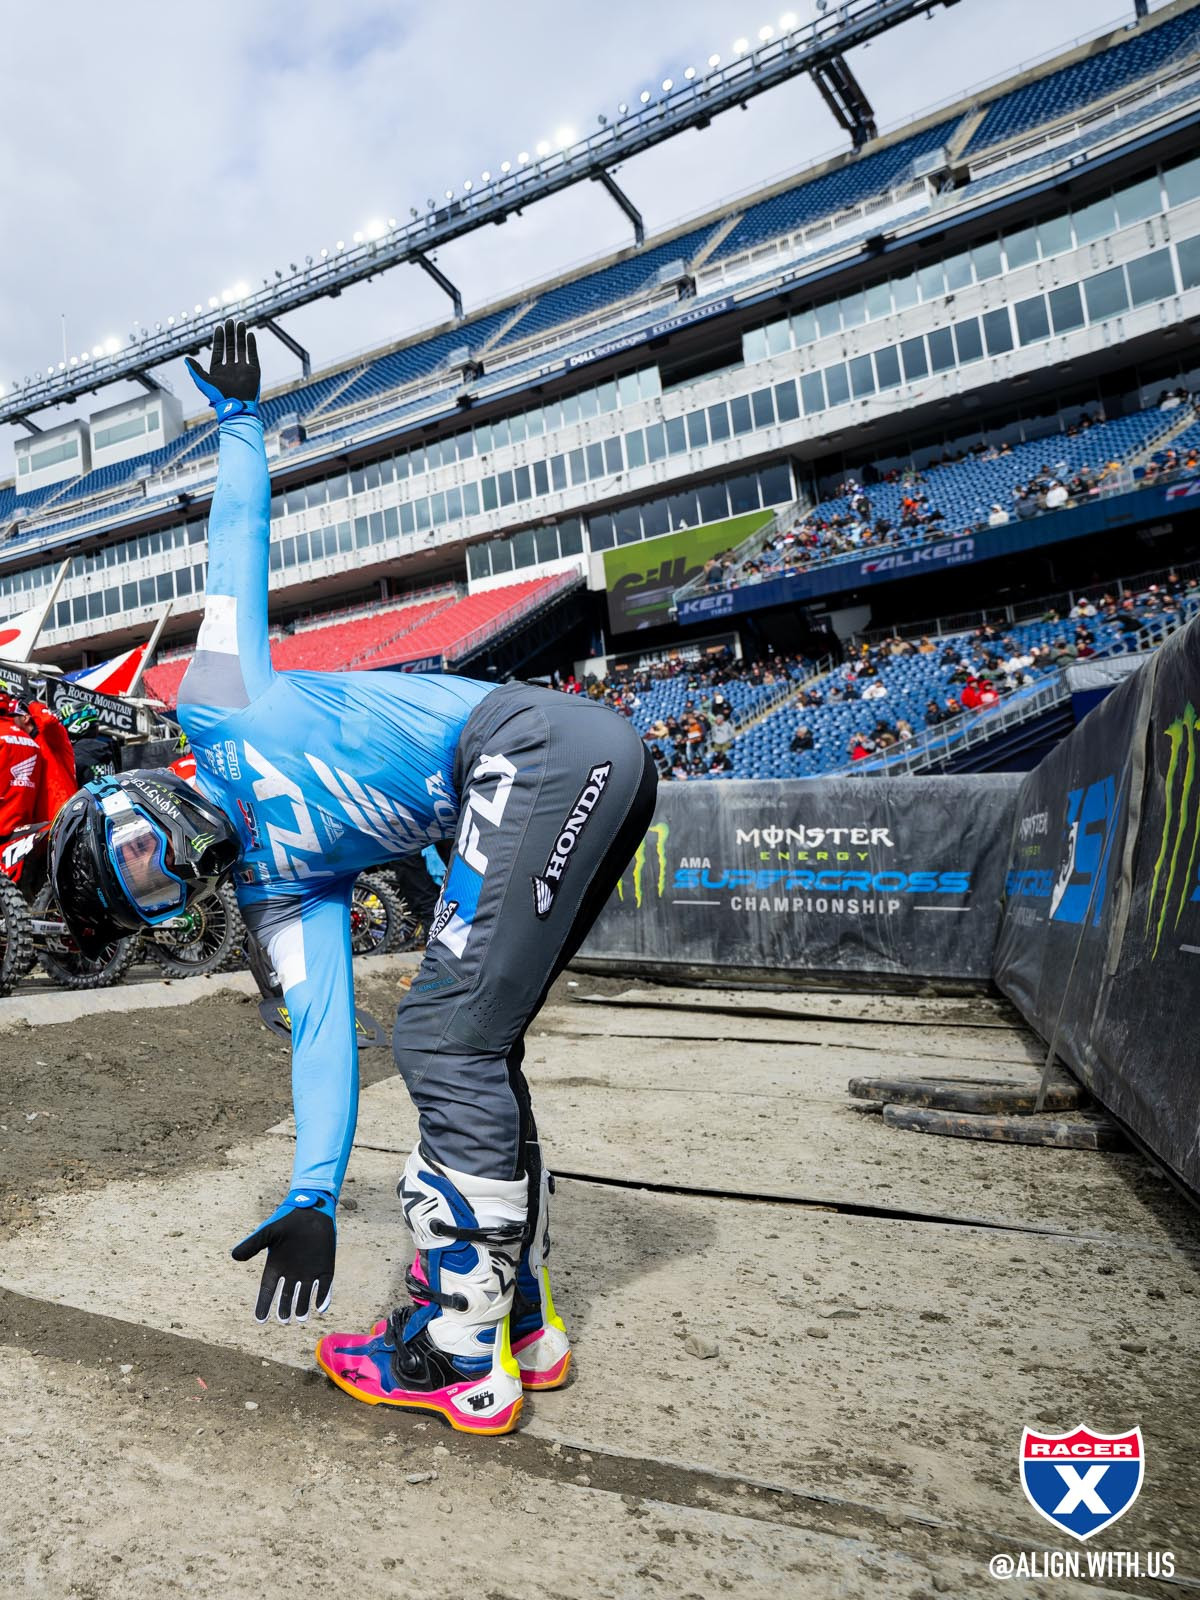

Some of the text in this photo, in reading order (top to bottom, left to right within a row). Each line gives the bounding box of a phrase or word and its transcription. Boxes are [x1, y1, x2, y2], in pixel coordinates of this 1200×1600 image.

[860, 538, 975, 575] FALKEN
[67, 685, 133, 717] ROCKY MOUNTAIN
[545, 763, 612, 881] HONDA
[736, 825, 895, 849] MONSTER
[680, 857, 712, 869] AMA
[760, 851, 869, 861] ENERGY
[672, 870, 973, 894] SUPERCROSS
[730, 896, 901, 915] CHAMPIONSHIP
